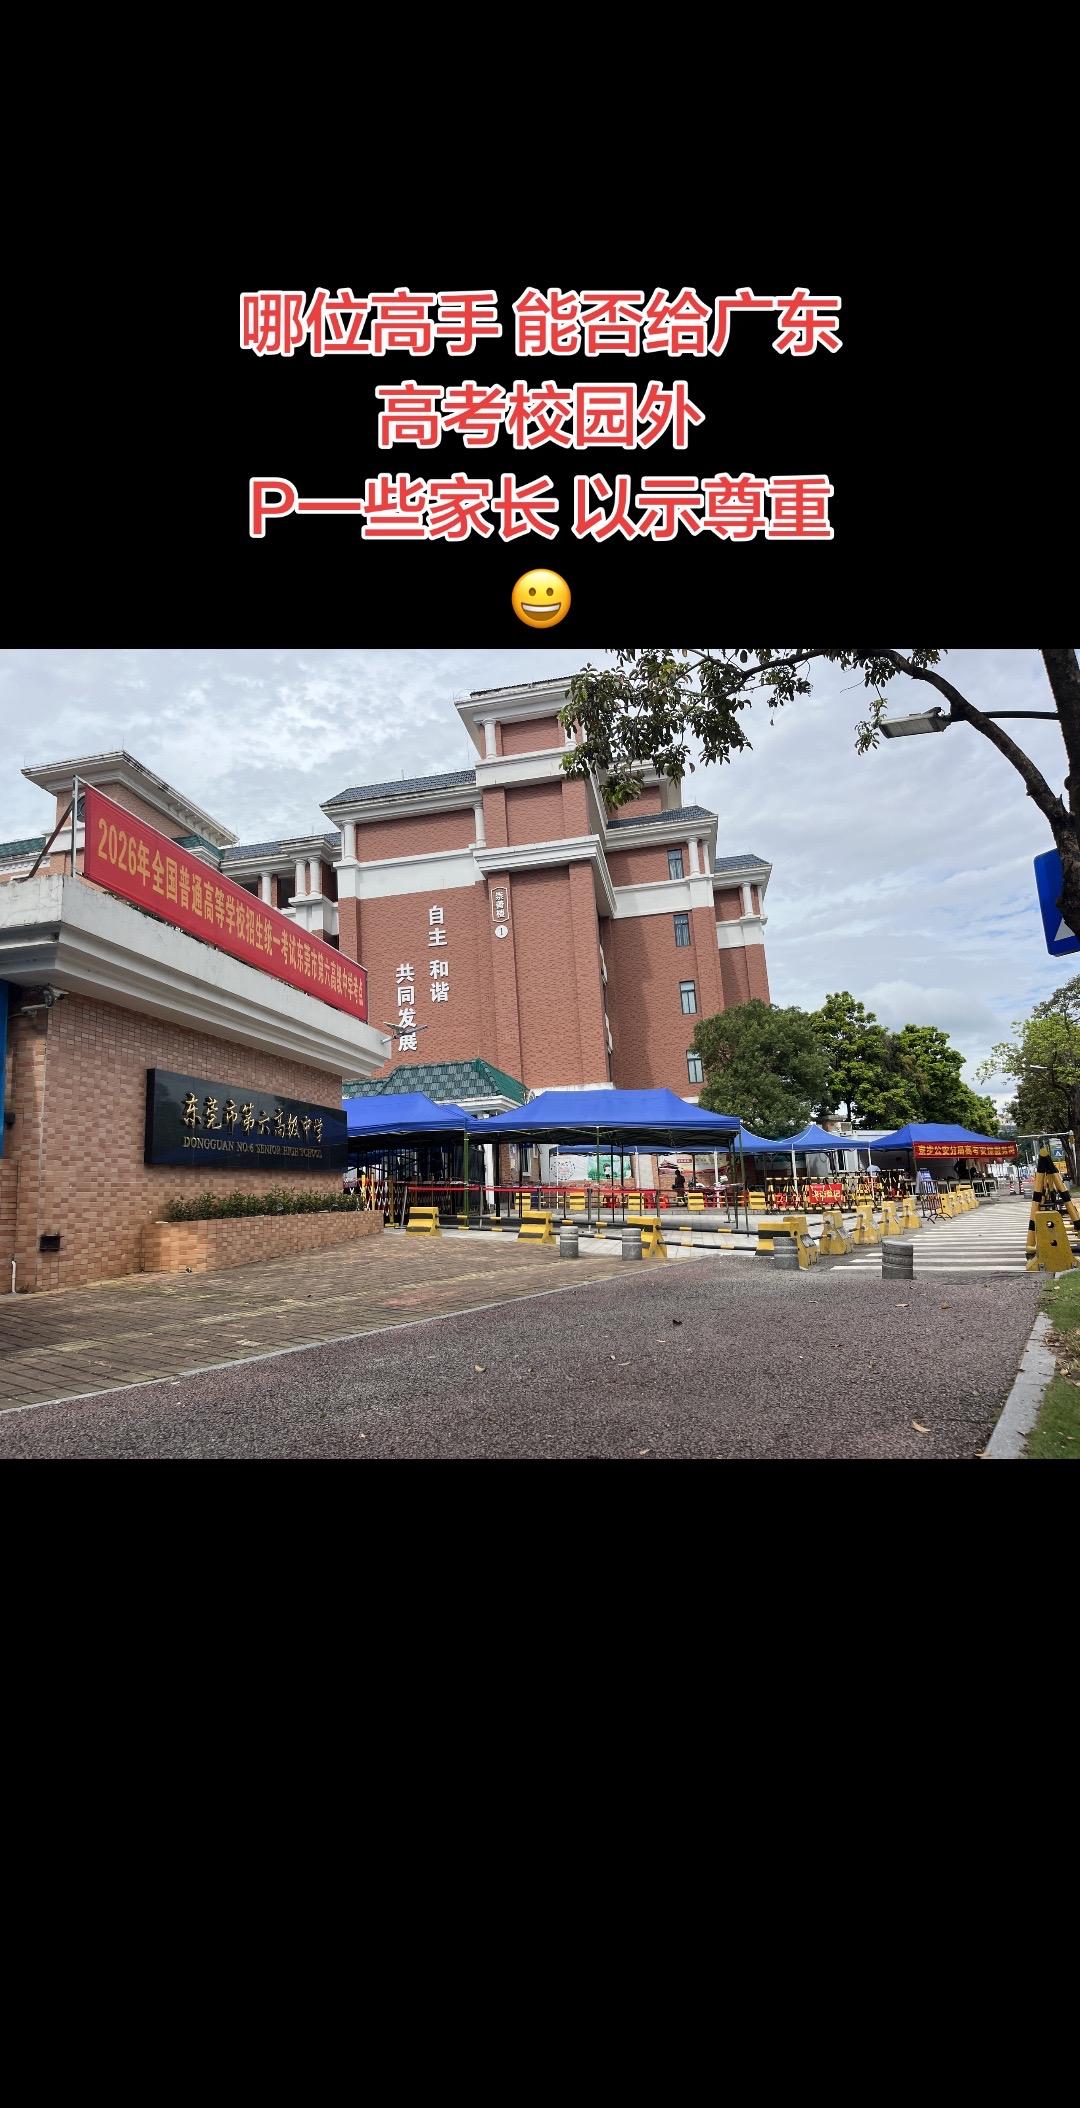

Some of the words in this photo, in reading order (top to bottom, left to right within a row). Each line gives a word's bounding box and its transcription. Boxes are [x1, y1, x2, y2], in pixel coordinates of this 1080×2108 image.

[98, 817, 365, 1007] 2026年全国普通高等学校招生统一考试东莞市第六高级中学考点
[428, 904, 448, 948] 自主
[429, 959, 450, 1003] 和谐
[395, 962, 418, 1052] 共同发展
[183, 1092, 324, 1143] 东莞市第六高级中学
[183, 1136, 234, 1151] DONGGUAN
[256, 1144, 280, 1155] SENIOR
[281, 1146, 299, 1157] HIGH
